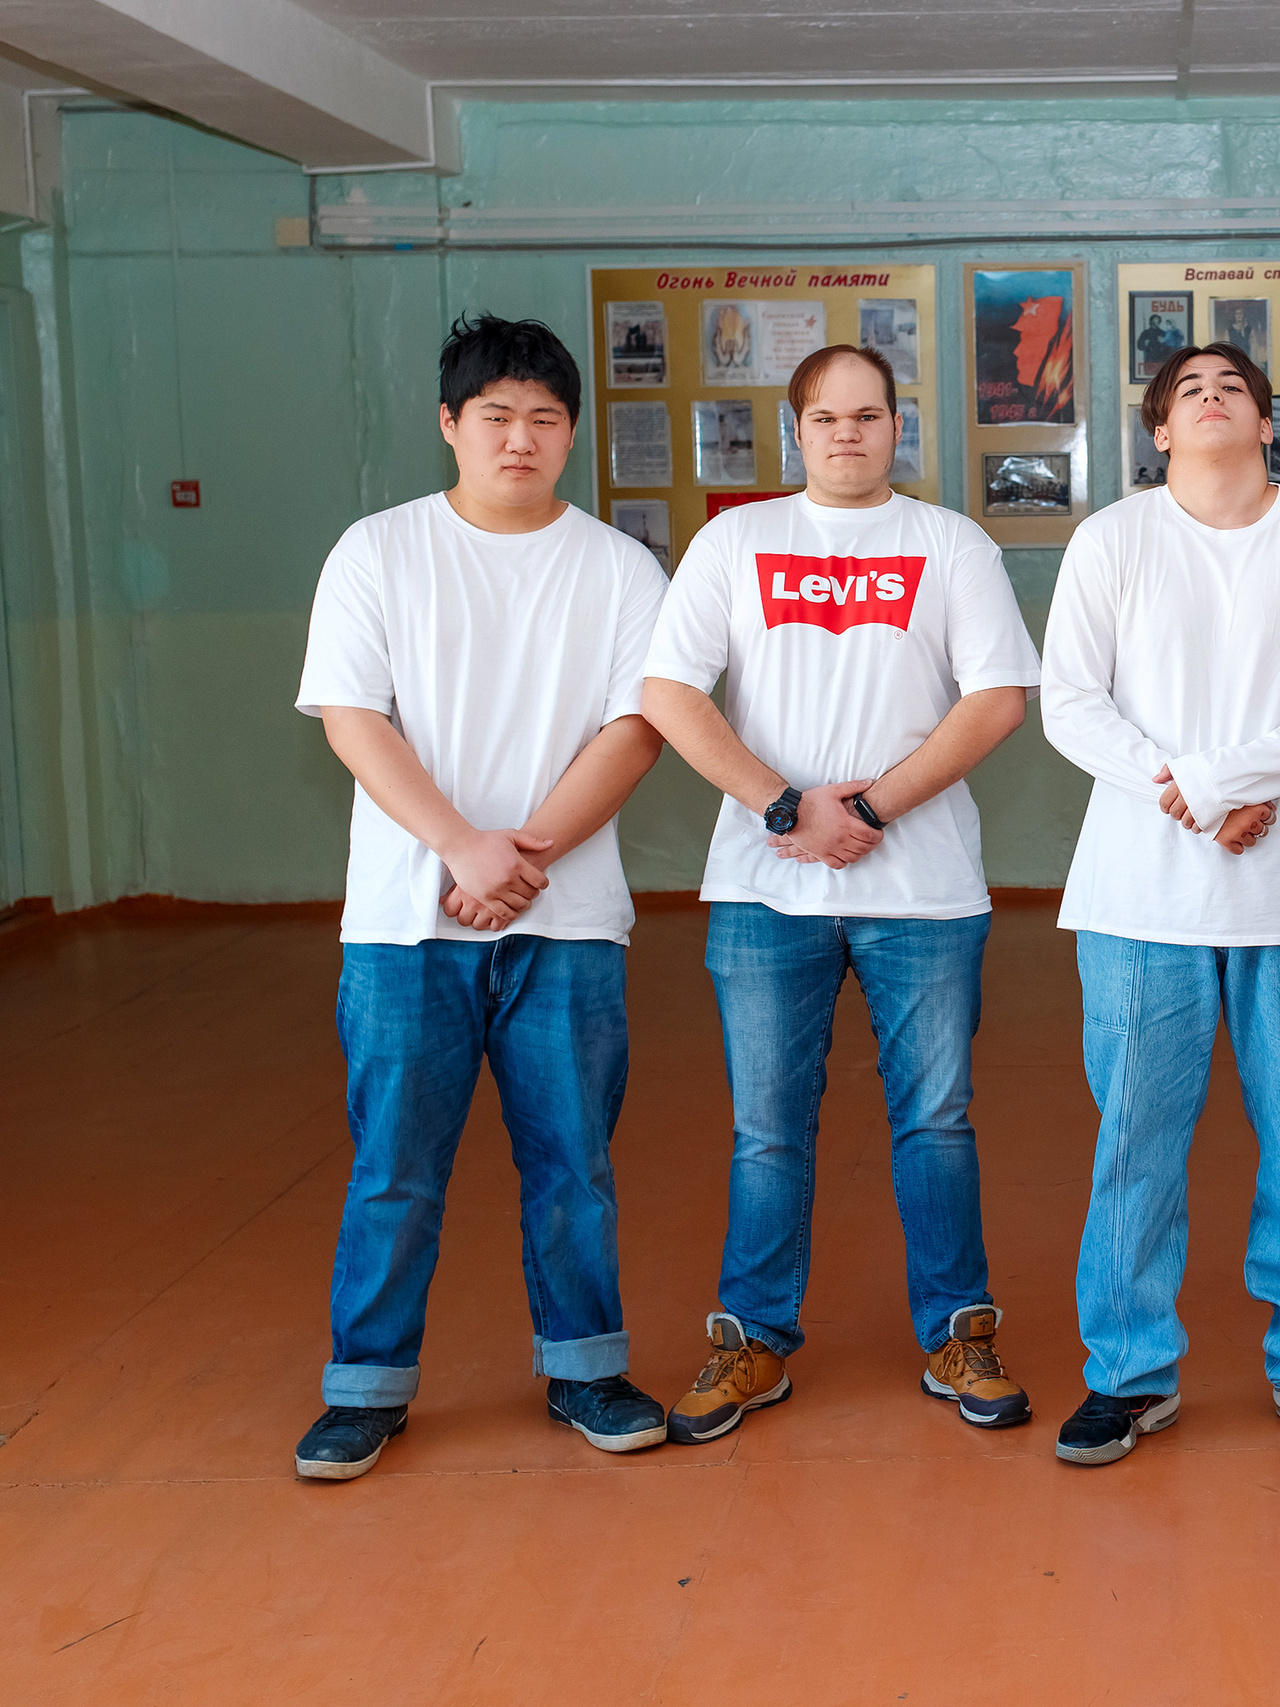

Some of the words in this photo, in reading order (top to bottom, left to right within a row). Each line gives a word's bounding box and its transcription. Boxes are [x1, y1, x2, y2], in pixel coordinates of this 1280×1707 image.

[656, 272, 715, 289] Огонь
[724, 269, 797, 288] Вечной
[807, 273, 890, 287] памяти
[1184, 266, 1254, 281] Вставай
[1151, 300, 1184, 313] БУДЬ
